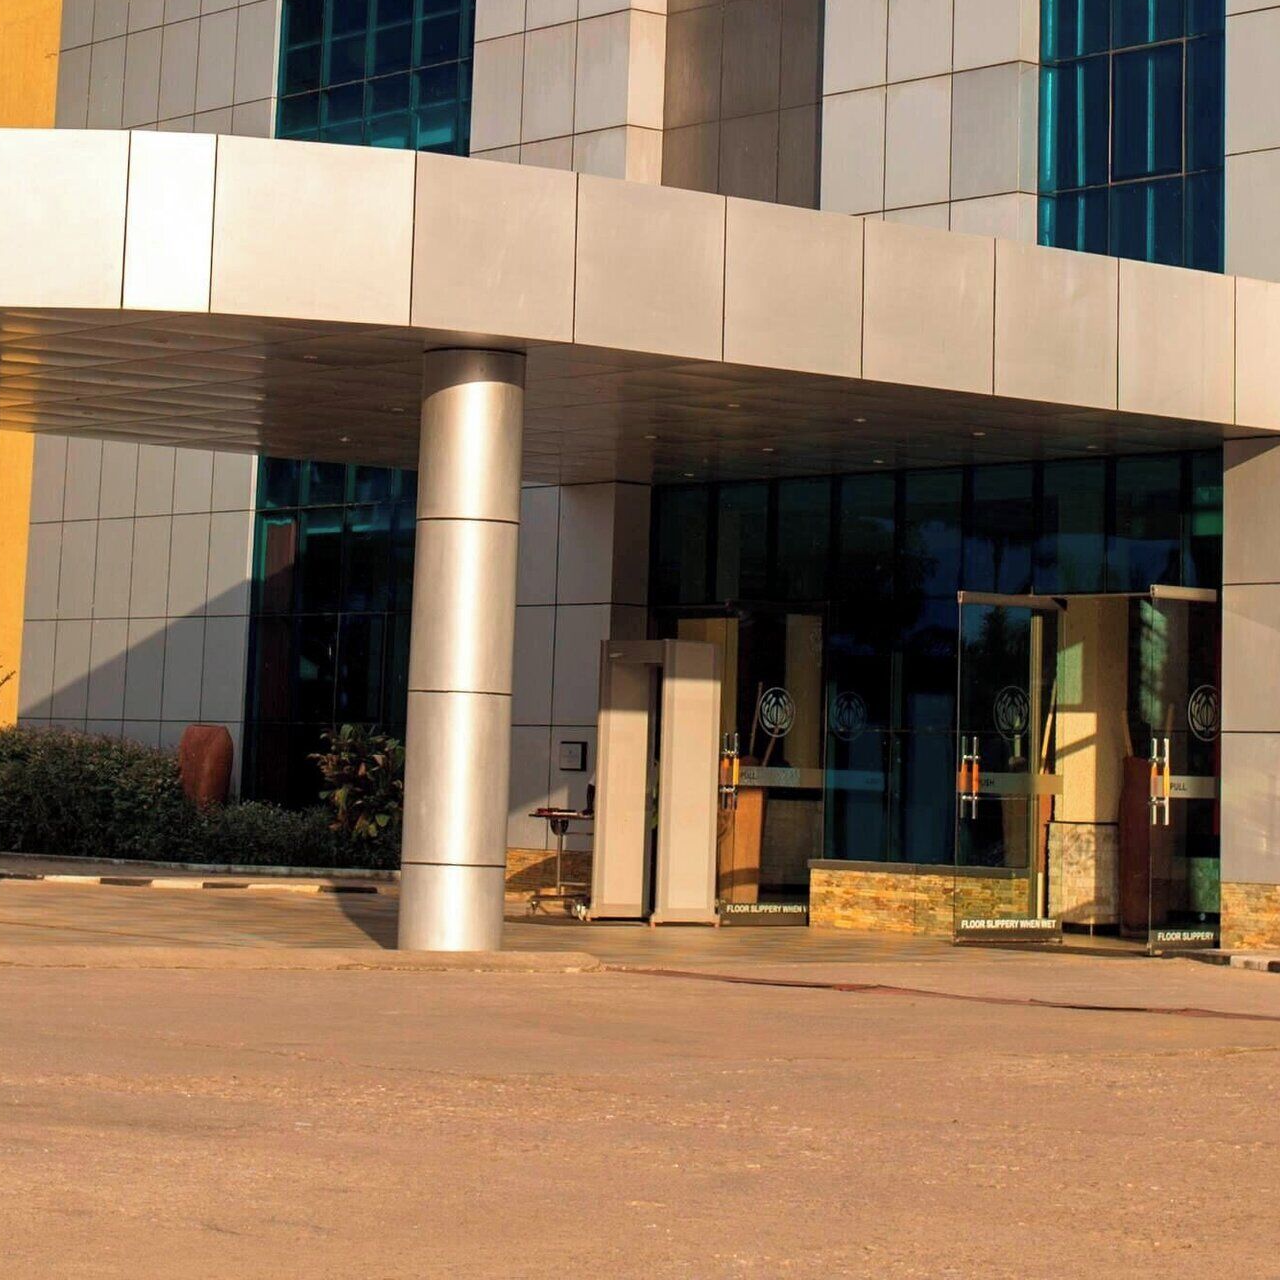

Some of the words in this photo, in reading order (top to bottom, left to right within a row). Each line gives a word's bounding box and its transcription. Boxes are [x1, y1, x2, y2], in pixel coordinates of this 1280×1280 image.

[726, 904, 749, 914] FLOOR
[751, 904, 781, 914] SLIPPERY
[782, 904, 802, 914] WHEN
[961, 919, 985, 929] FLOOR
[986, 919, 1018, 929] SLIPPERY
[1020, 919, 1040, 929] WHEN
[1041, 919, 1056, 929] WET
[1157, 931, 1181, 941] FLOOR
[1182, 931, 1214, 941] SLIPPERY
